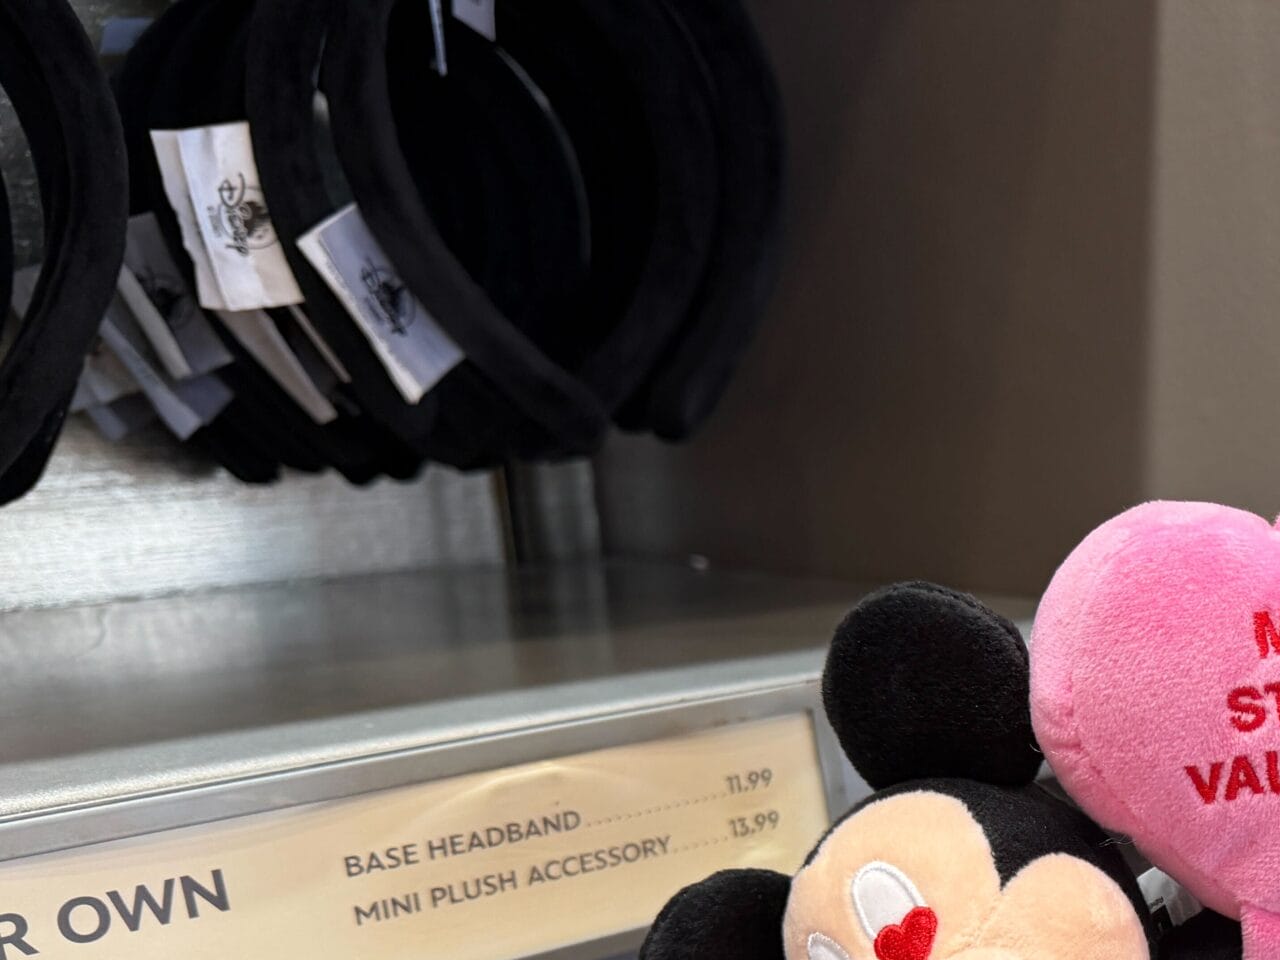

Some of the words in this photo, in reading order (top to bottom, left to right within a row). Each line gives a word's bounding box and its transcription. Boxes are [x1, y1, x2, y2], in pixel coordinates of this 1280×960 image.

[344, 843, 419, 878] BASE
[427, 809, 583, 862] HEADBAND
[725, 768, 774, 796] 11.99
[353, 892, 423, 927] MINI
[430, 870, 518, 909] PLUSH
[527, 834, 673, 888] ACCESSORY
[728, 809, 781, 840] 13.99
[57, 868, 231, 944] OWN
